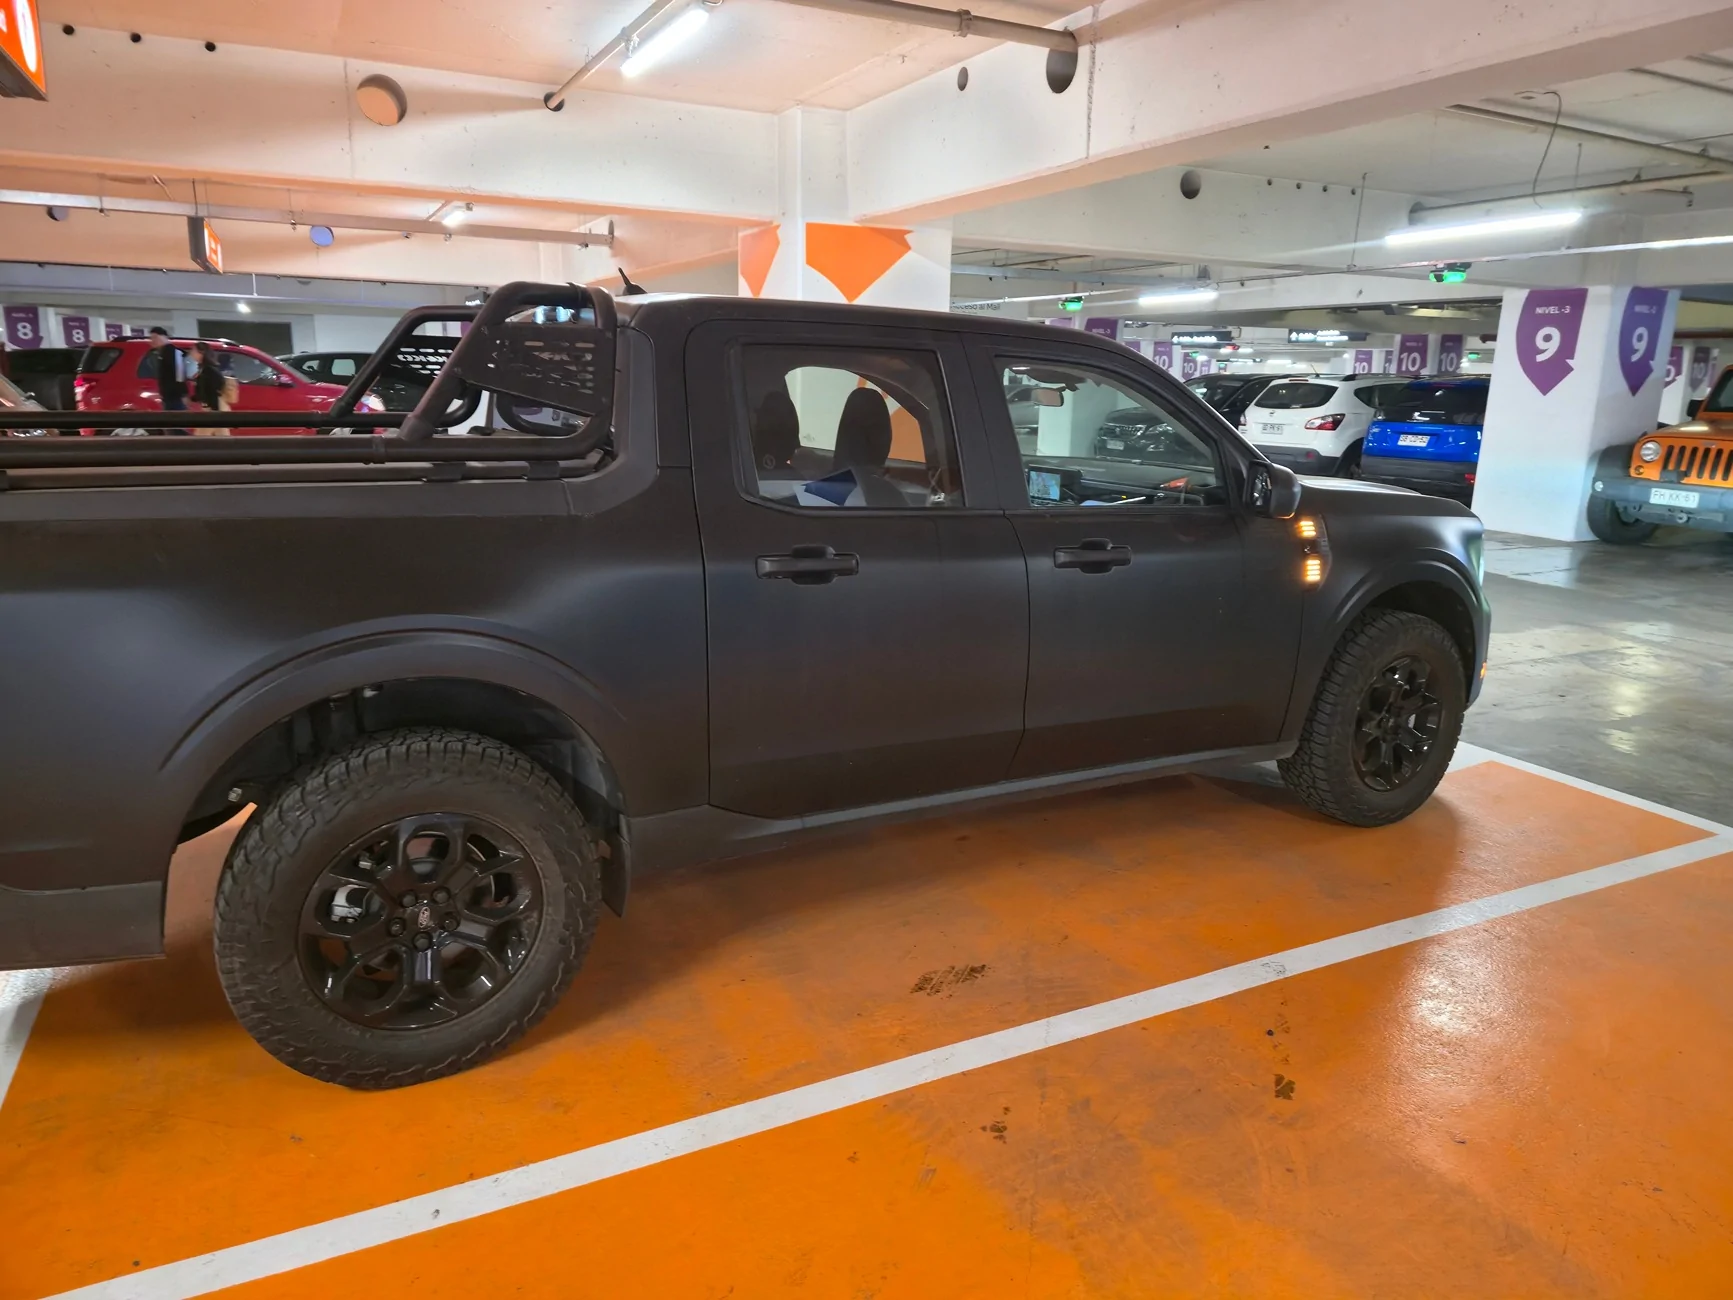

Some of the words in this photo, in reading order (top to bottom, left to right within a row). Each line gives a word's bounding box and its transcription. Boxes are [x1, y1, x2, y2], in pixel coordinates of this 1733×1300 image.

[1535, 305, 1560, 314] NIVEL
[1561, 305, 1571, 314] -3
[16, 322, 34, 340] 8
[72, 328, 86, 343] 8
[1535, 326, 1561, 362] 9
[1630, 326, 1649, 362] 9
[1154, 355, 1169, 370] 10
[1183, 362, 1195, 374] 10
[1354, 362, 1369, 373] 10
[1400, 352, 1421, 372] 10
[1440, 352, 1457, 372] 10
